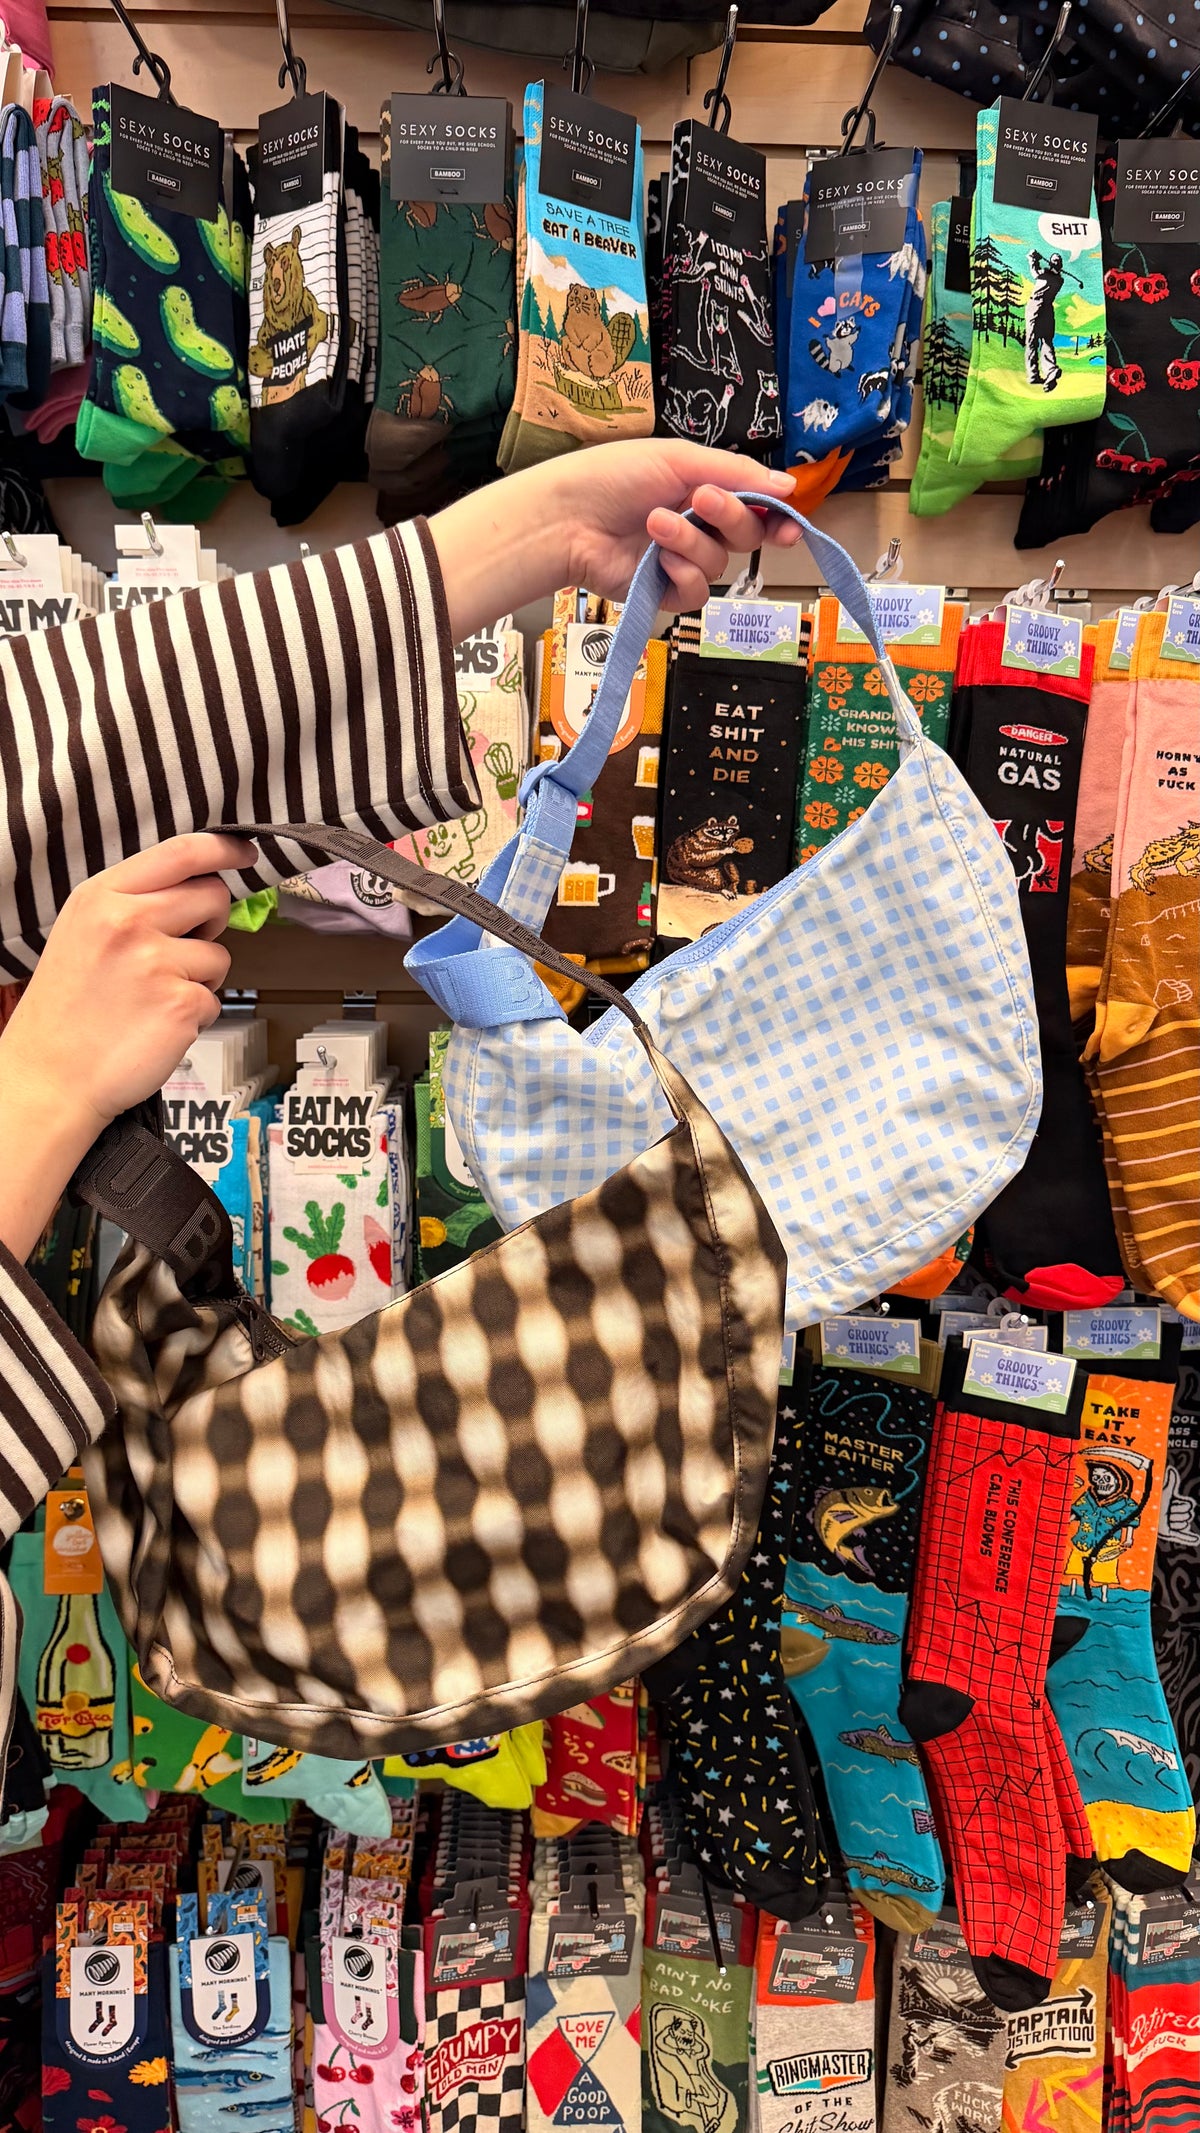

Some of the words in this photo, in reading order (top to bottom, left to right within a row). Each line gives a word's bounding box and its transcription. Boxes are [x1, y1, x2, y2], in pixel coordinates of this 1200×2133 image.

[119, 117, 156, 139] SEXY
[163, 132, 210, 159] SOCKS
[263, 137, 285, 155] SEXY
[288, 125, 319, 146] SOCKS
[400, 123, 438, 136] SEXY
[445, 125, 497, 139] SOCKS
[549, 116, 582, 138] SEXY
[588, 130, 629, 156] SOCKS
[1004, 127, 1038, 145] SEXY
[1043, 135, 1089, 154] SOCKS
[151, 173, 177, 188] BAMBOO
[434, 170, 461, 178] BAMBOO
[575, 173, 598, 187] BAMBOO
[696, 151, 723, 173] SEXY
[726, 165, 761, 191] SOCKS
[1126, 169, 1162, 181] SEXY
[1168, 169, 1199, 181] SOC
[283, 179, 300, 189] BAMBOO
[818, 184, 850, 201] SEXY
[855, 179, 904, 194] SOCKS
[1030, 178, 1054, 188] BAMBOO
[546, 202, 584, 223] SAVE
[586, 214, 597, 227] A
[598, 218, 632, 239] TREE
[714, 205, 733, 218] BAMBOO
[842, 223, 867, 232] BAMBOO
[1051, 222, 1088, 236] SHIT
[542, 218, 570, 240] EAT
[572, 228, 582, 244] A
[583, 231, 638, 259] BEAVER
[713, 274, 746, 304] STUNTS
[839, 290, 881, 318] CATS
[273, 343, 279, 359] I
[278, 330, 306, 356] HATE
[270, 351, 307, 380] PEOPLE
[729, 612, 772, 628] GROOVY
[875, 614, 911, 628] HINGS
[1027, 623, 1062, 642] GROOVY
[715, 702, 764, 721] EAT
[708, 724, 765, 742] SHIT
[846, 721, 898, 735] KNOW
[1011, 727, 1053, 743] DANGER
[841, 736, 866, 748] HIS
[870, 739, 902, 750] SHIT
[709, 746, 760, 763] AND
[999, 746, 1061, 766] NATURAL
[713, 767, 751, 783] DIE
[997, 761, 1061, 791] GAS
[1168, 766, 1188, 776] AS
[1157, 779, 1196, 791] FUCK
[163, 1100, 185, 1130] AT
[188, 1100, 231, 1130] MY
[288, 1096, 332, 1126] EAT
[333, 1096, 373, 1126] MY
[287, 1127, 371, 1158] SOCKS
[1089, 1319, 1132, 1331] GROOVY
[847, 1328, 889, 1343] GROOVY
[996, 1358, 1043, 1378] GROOVY
[1090, 1402, 1140, 1419] TAKE
[1171, 1415, 1199, 1425] OOL
[1103, 1418, 1125, 1432] IT
[1169, 1427, 1190, 1437] ASS
[824, 1430, 904, 1462] MASTER
[1083, 1428, 1136, 1447] EASY
[1168, 1439, 1199, 1449] NCLE
[823, 1444, 896, 1475] BAITER
[985, 1473, 1003, 1505] CALL
[1006, 1478, 1022, 1508] THIS
[979, 1508, 998, 1558] BLOWS
[993, 1509, 1018, 1595] CONFERENCE
[218, 1976, 248, 1986] MORNINGS
[656, 1963, 700, 1987] AIN'T
[705, 1979, 732, 1991] NO
[340, 1981, 354, 1989] MANY
[355, 1984, 380, 1995] MORNINGS
[648, 1976, 683, 1997] BAD
[690, 1992, 735, 2014] JOKE
[565, 2020, 605, 2033] LOVE
[1007, 2008, 1094, 2037] CAPTAIN
[575, 2035, 597, 2049] ME
[1153, 2035, 1186, 2048] FUCK
[426, 2023, 518, 2082] GRUMPY
[441, 2066, 460, 2092] OLD
[466, 2058, 501, 2076] MAN
[577, 2071, 594, 2085] A
[774, 2053, 866, 2089] RINGMASTER
[566, 2085, 608, 2105] GOOD
[954, 2090, 992, 2112] FUCK
[562, 2104, 612, 2122] POOP
[799, 2101, 812, 2114] OF
[822, 2097, 853, 2109] THE
[951, 2102, 994, 2125] WORK
[818, 2112, 876, 2133] Show
